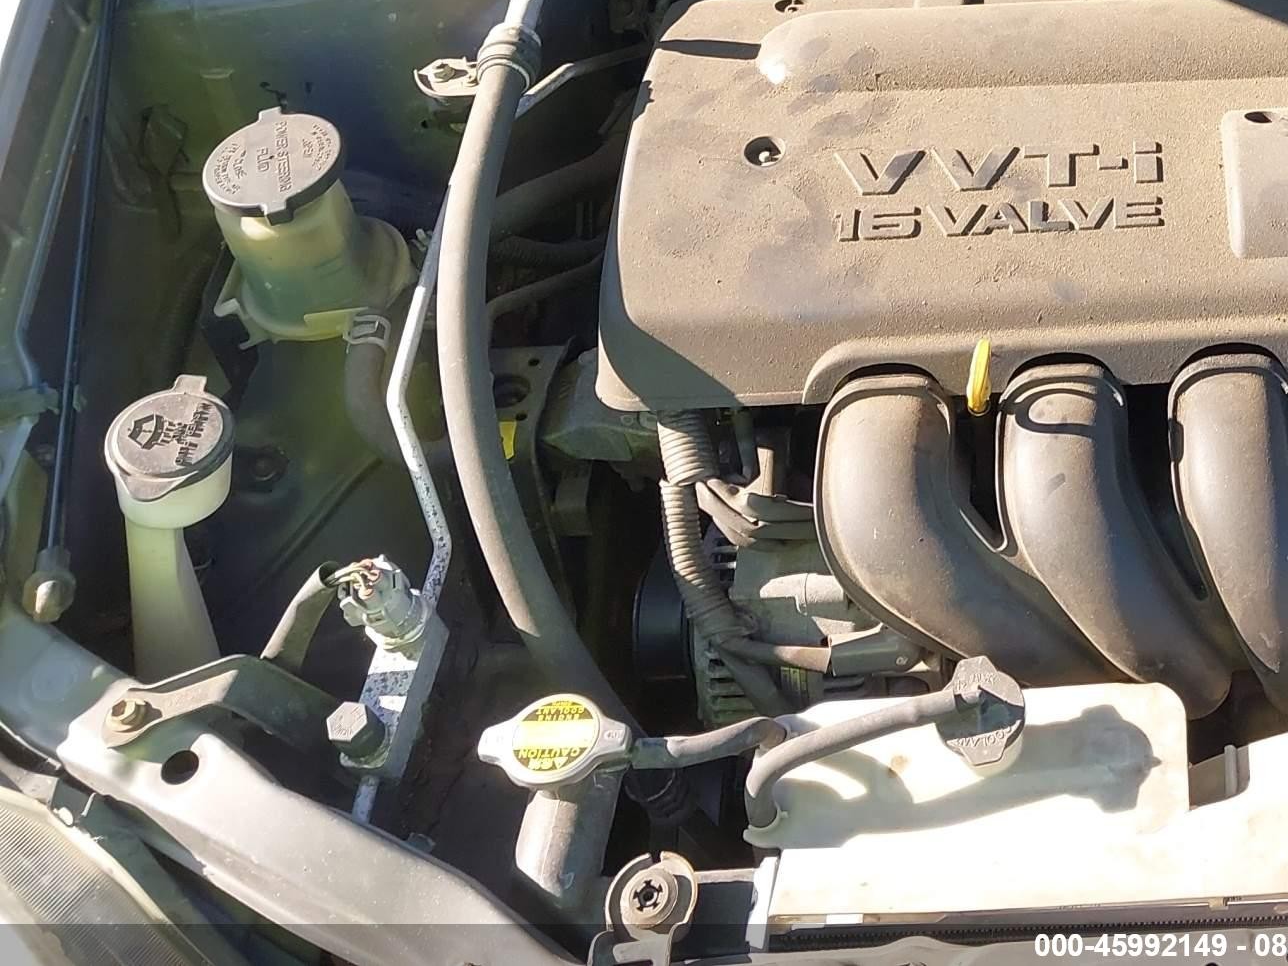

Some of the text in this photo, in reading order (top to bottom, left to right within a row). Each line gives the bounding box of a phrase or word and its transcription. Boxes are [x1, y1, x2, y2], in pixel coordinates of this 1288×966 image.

[275, 121, 292, 193] POWER STEERING
[834, 140, 1164, 195] VVT-i
[836, 196, 1166, 242] 16 VALVE
[535, 706, 585, 715] COOLANT
[518, 747, 581, 759] CAUTION
